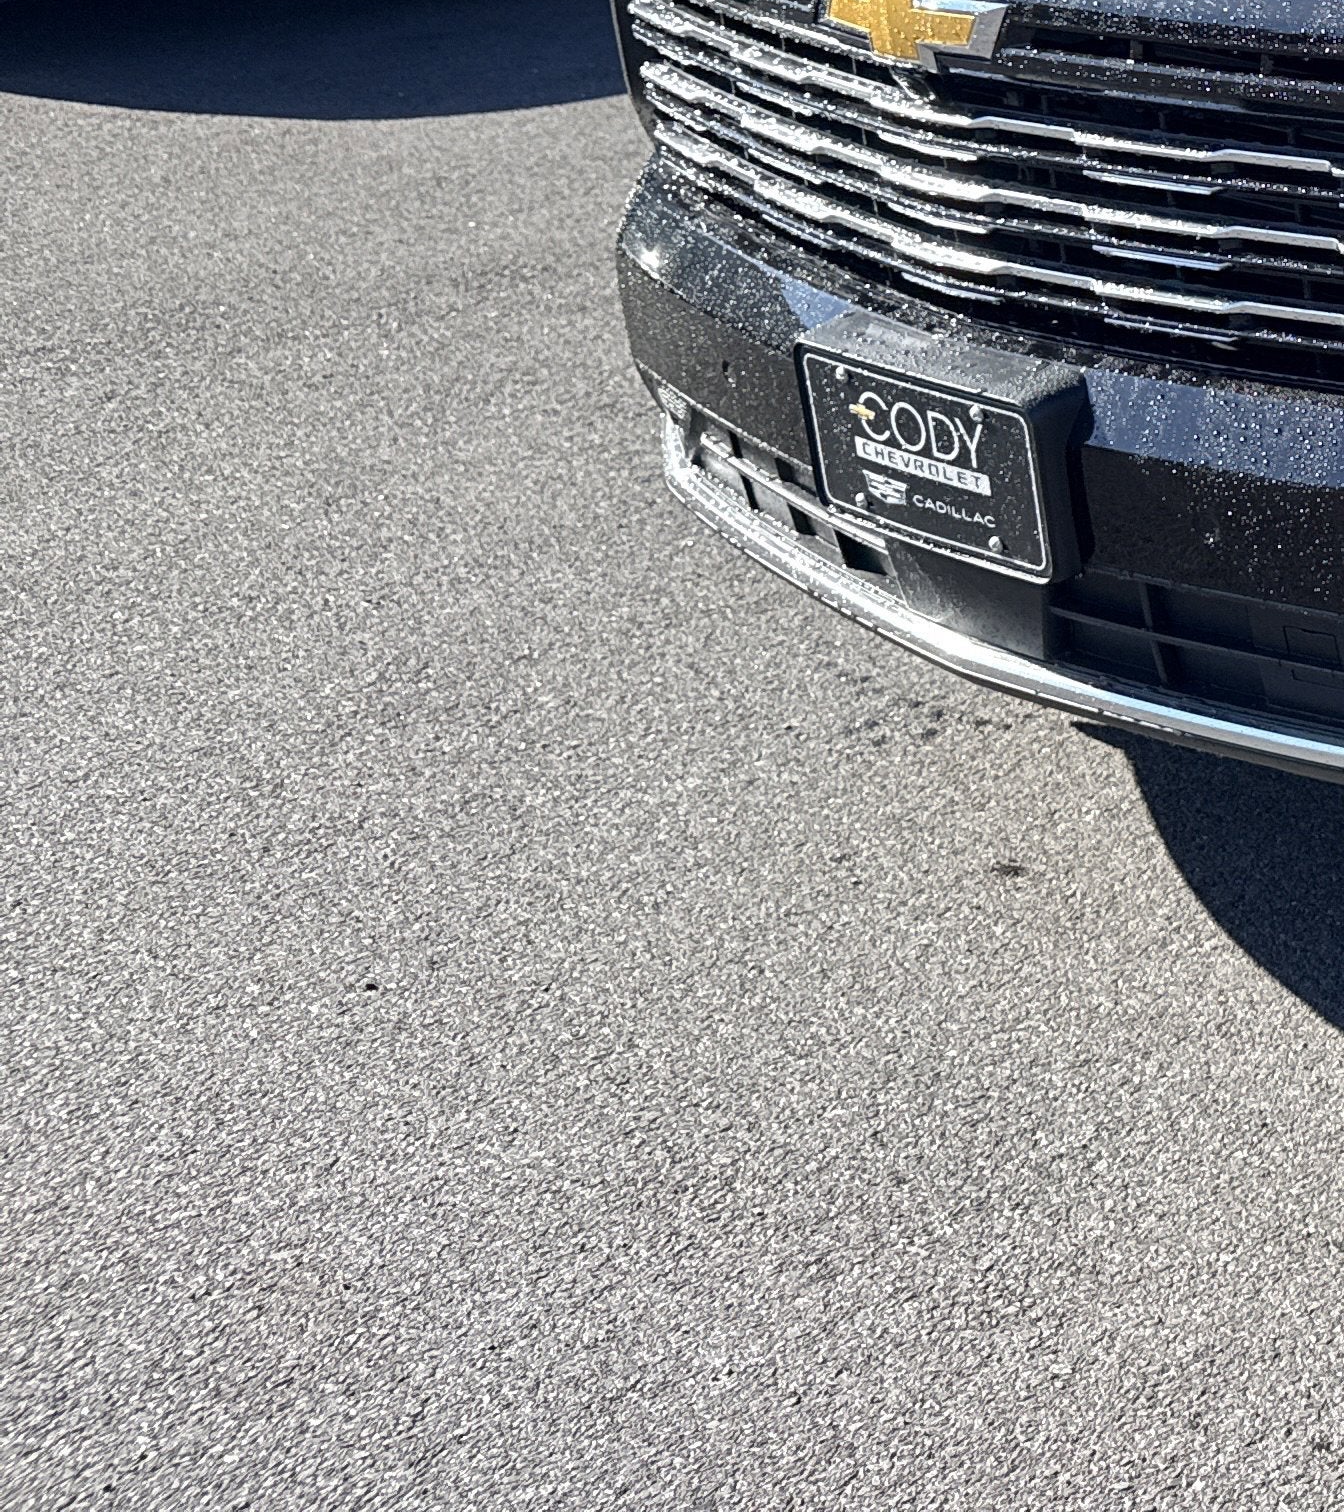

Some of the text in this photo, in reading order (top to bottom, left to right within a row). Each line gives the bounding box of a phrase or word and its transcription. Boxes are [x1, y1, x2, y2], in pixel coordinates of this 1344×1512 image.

[856, 391, 984, 469] CODY
[861, 441, 982, 489] CHEVROLET
[912, 494, 997, 529] CADILLAC
